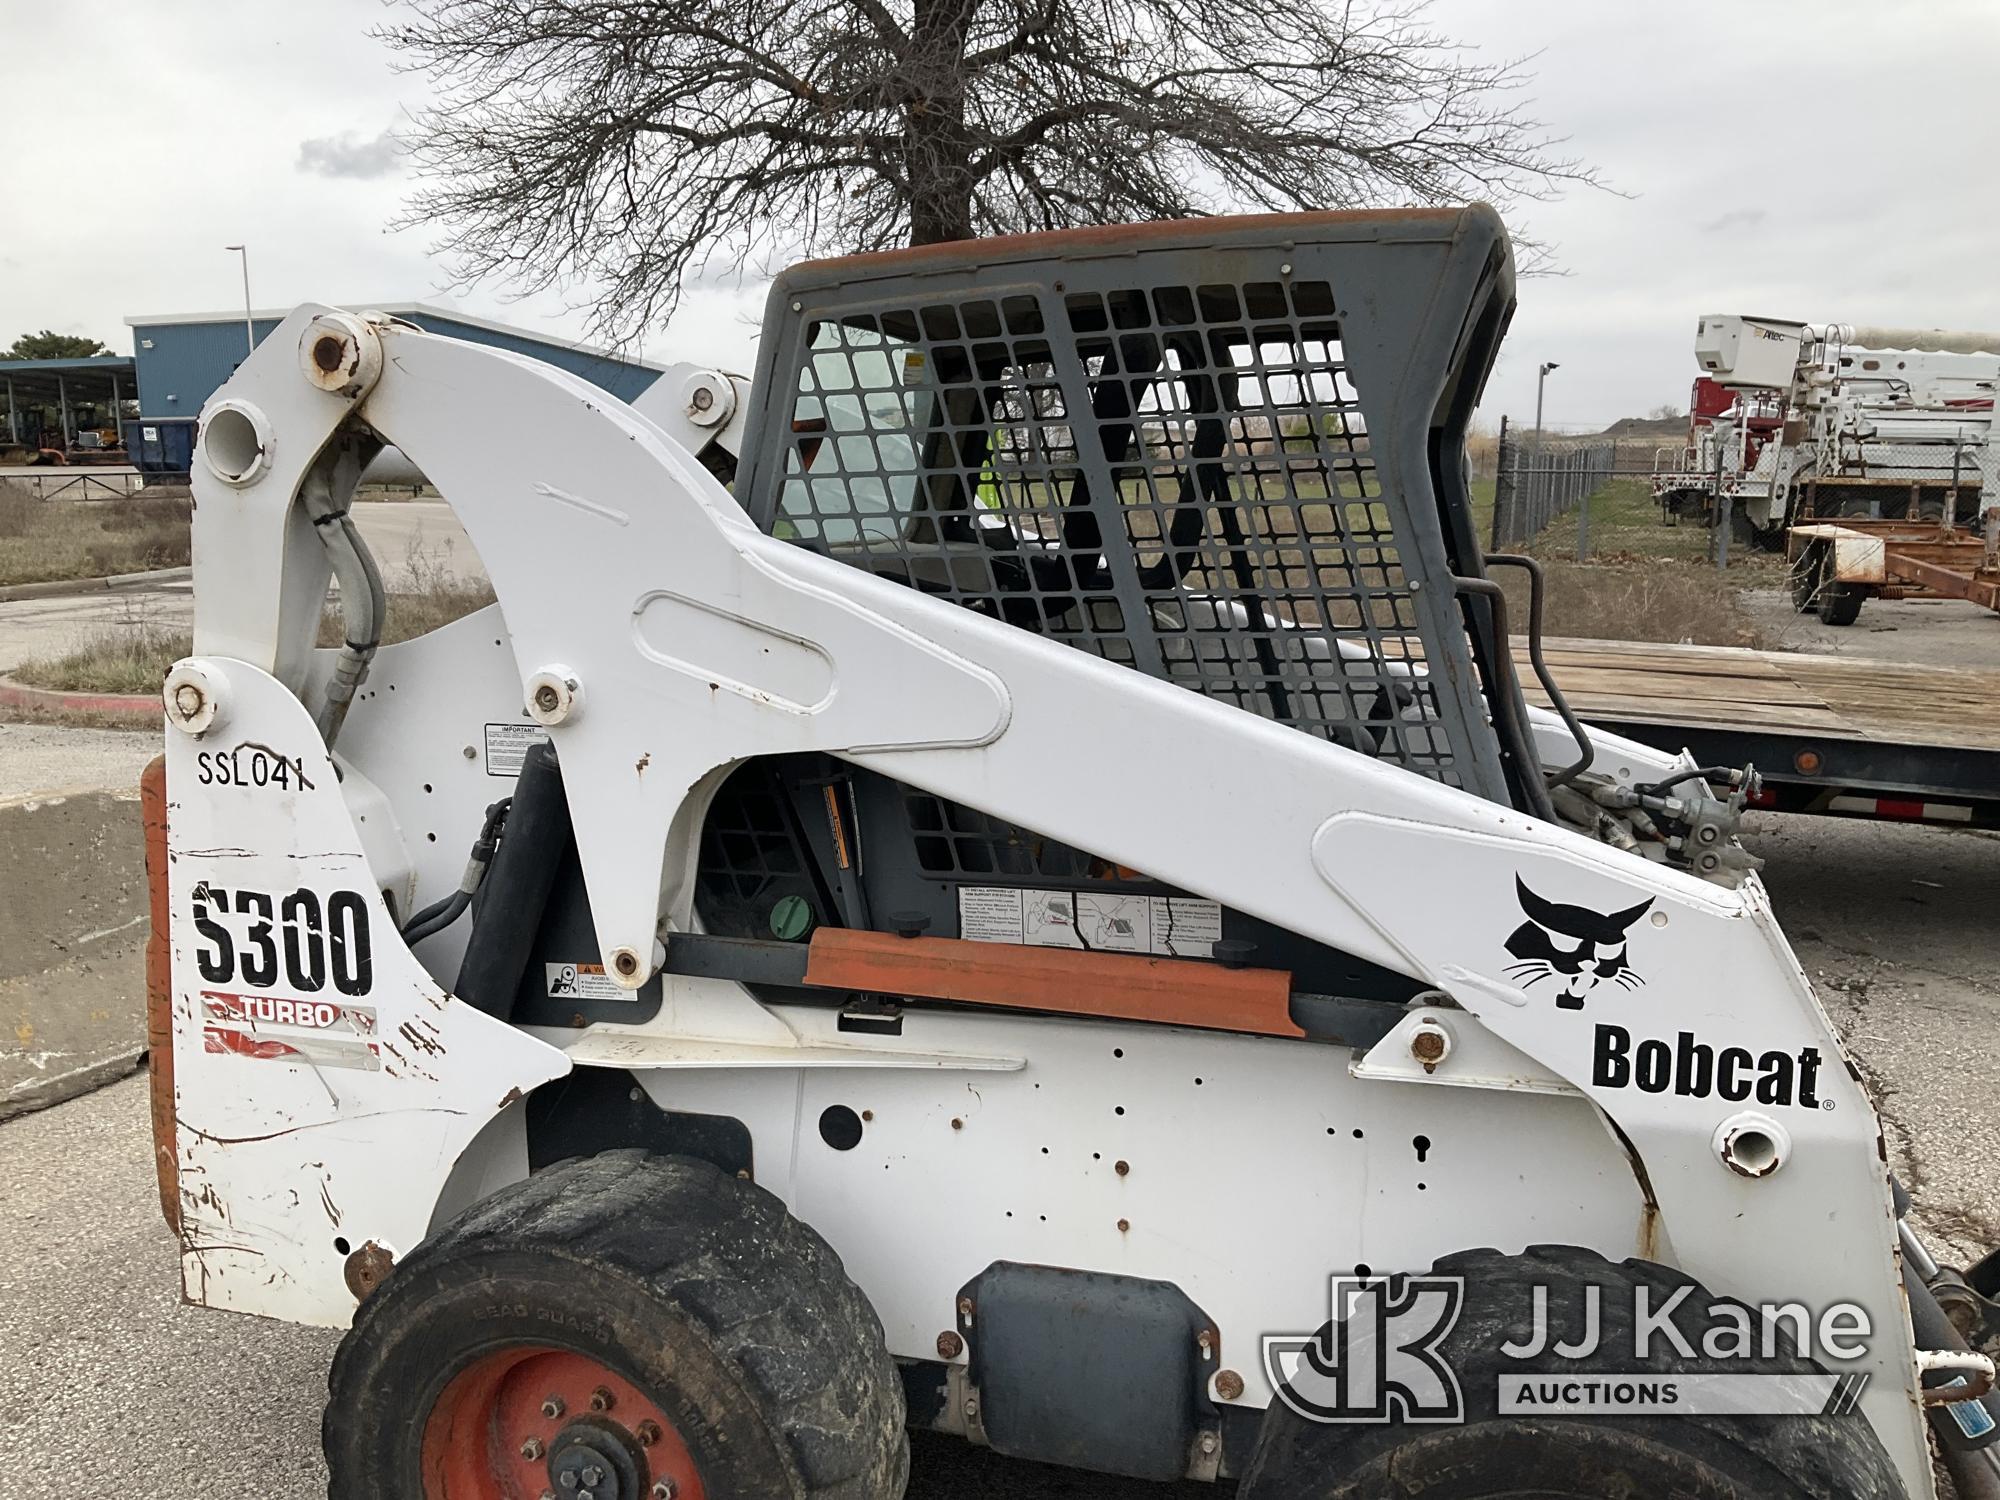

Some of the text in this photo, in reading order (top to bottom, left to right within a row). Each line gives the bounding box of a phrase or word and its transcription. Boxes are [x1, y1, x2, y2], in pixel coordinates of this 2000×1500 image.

[1763, 329, 1785, 342] Altec
[198, 752, 304, 791] SSL041
[192, 881, 373, 997] S300
[240, 996, 335, 1028] TURBO
[1592, 1023, 1822, 1109] Bobcat
